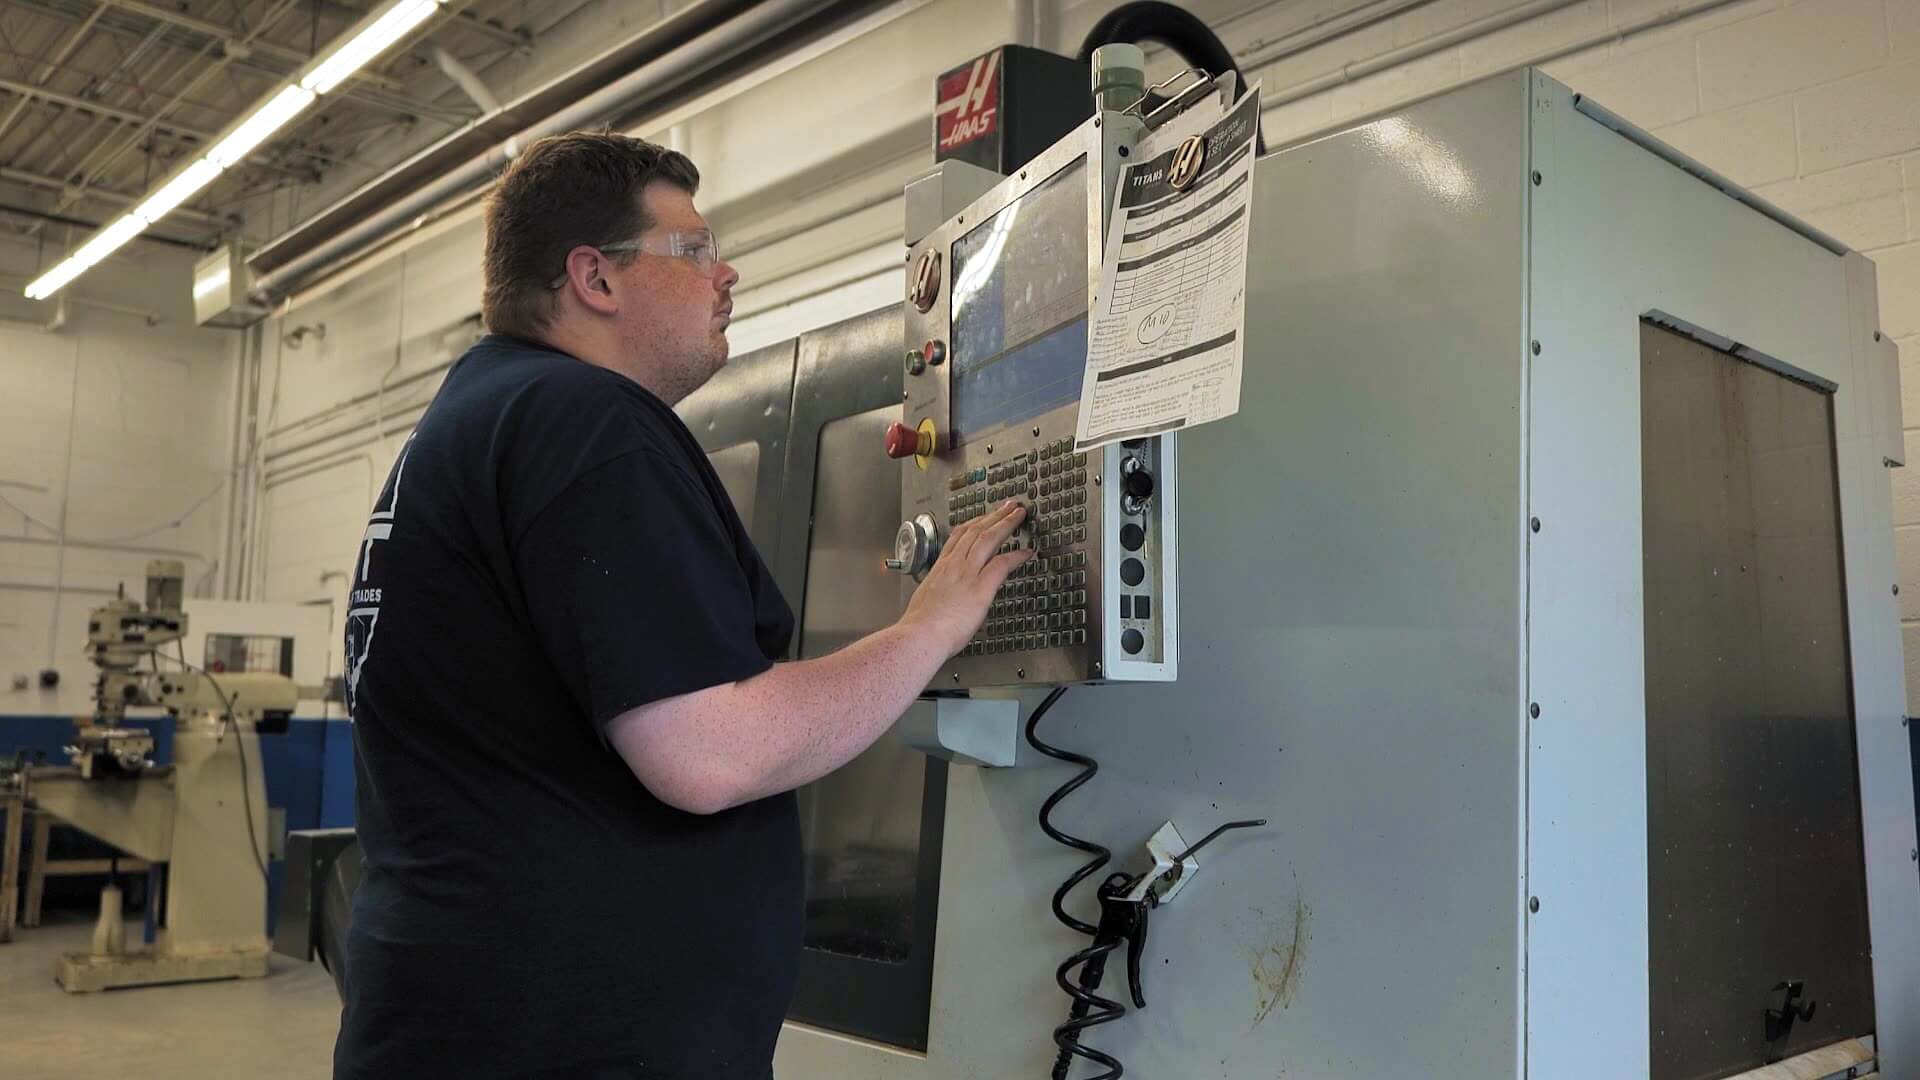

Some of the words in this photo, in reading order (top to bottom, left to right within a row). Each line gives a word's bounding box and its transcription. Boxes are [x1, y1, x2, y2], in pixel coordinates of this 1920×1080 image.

[941, 107, 996, 147] HAAS
[1132, 168, 1163, 186] TITANS
[354, 588, 382, 603] TRADES
